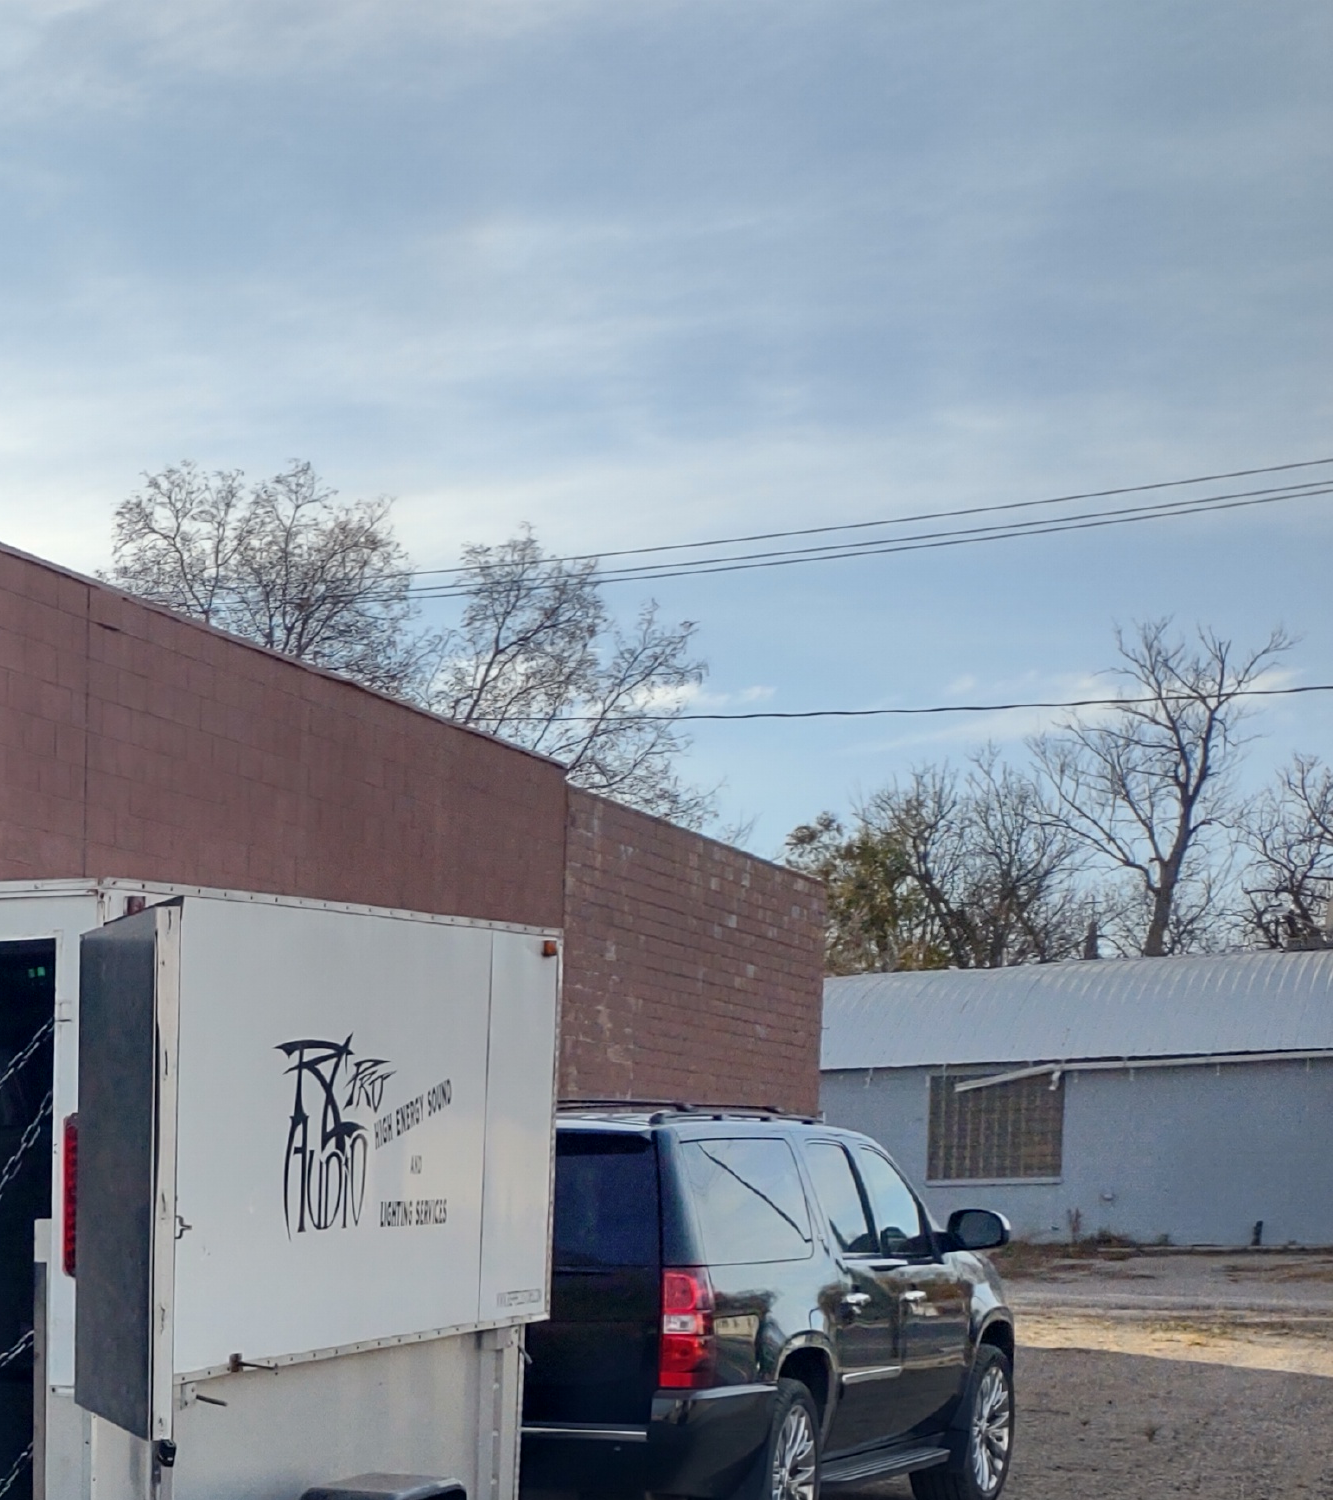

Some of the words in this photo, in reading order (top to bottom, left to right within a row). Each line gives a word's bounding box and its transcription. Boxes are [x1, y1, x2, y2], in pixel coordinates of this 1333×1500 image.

[374, 1112, 393, 1150] HIGH
[396, 1094, 424, 1137] ENERGY
[427, 1078, 452, 1117] SOUND
[410, 1154, 422, 1175] AND
[380, 1200, 412, 1228] LIGHTING
[415, 1198, 447, 1226] SERVICES
